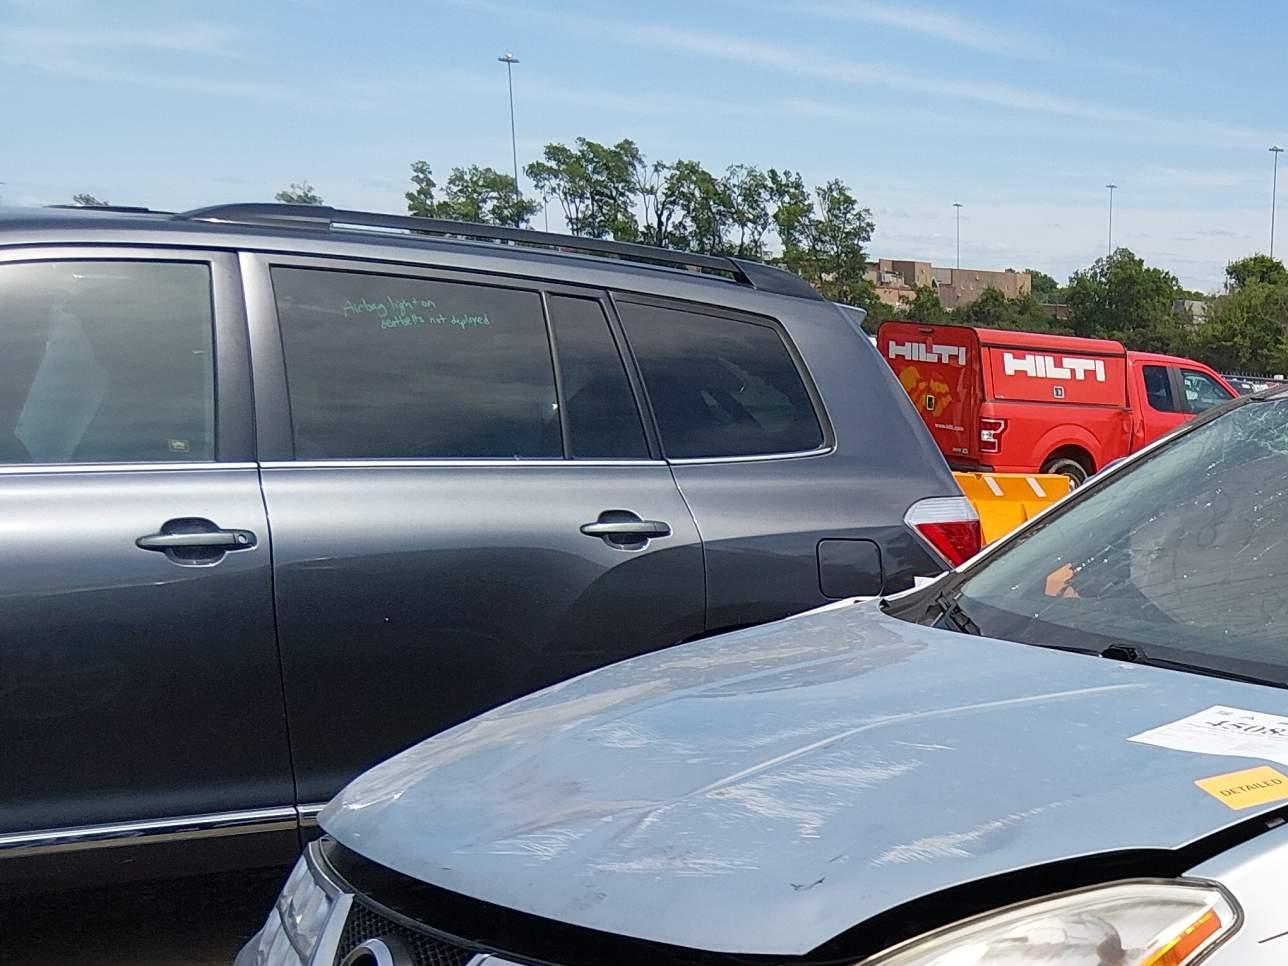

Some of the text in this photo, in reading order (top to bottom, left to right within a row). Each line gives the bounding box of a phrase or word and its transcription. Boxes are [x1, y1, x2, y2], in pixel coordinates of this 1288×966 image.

[343, 295, 437, 318] Airbag light on
[430, 313, 448, 325] not
[451, 313, 490, 329] deployed
[888, 340, 967, 366] HILTI
[1003, 352, 1106, 382] HILTI
[1219, 778, 1284, 797] DETAILED
